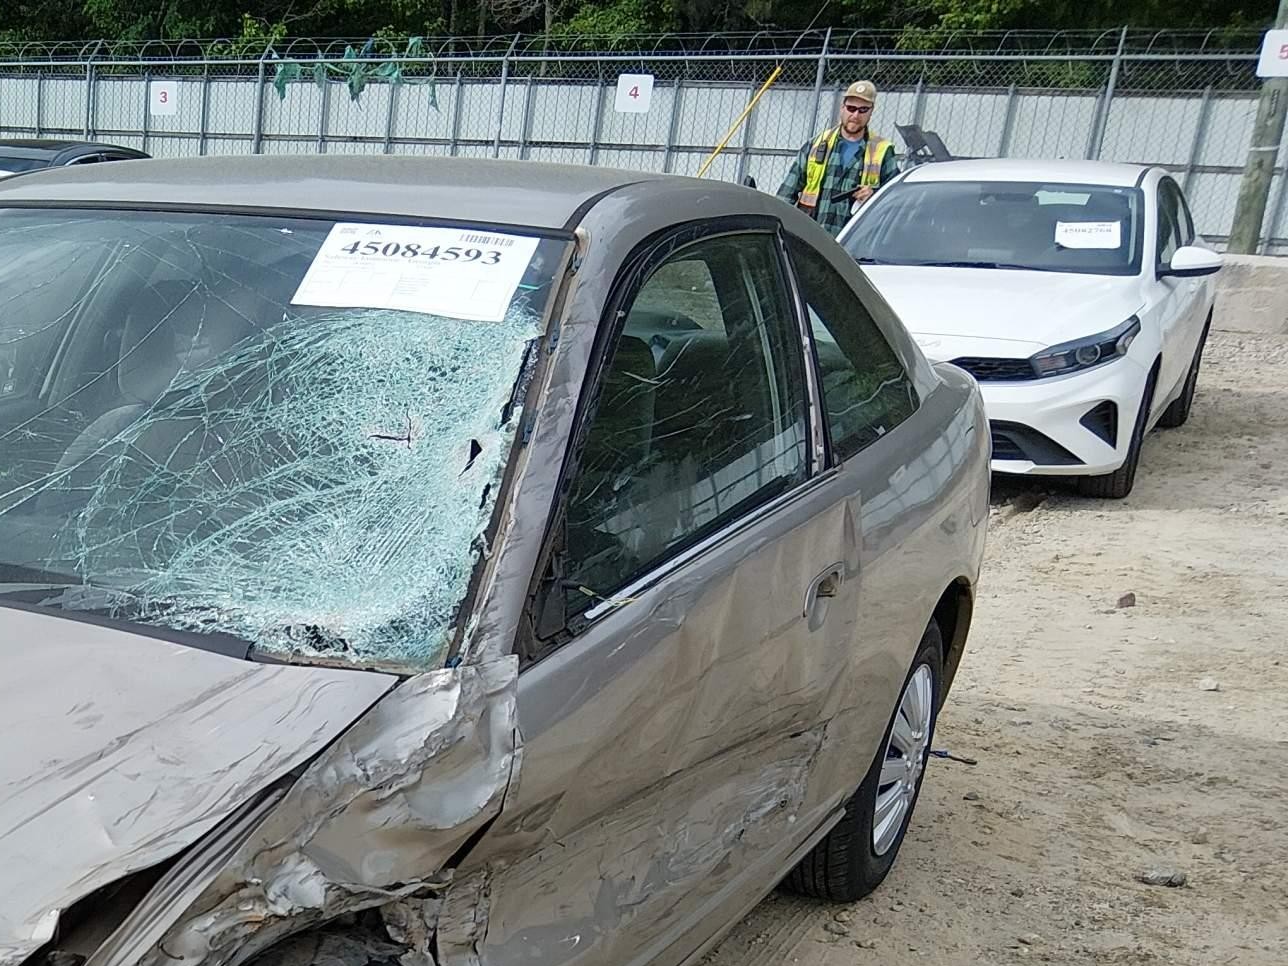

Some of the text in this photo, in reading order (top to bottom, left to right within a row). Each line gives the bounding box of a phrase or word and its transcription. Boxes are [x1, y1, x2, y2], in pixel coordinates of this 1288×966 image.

[159, 91, 168, 103] 3
[629, 86, 640, 99] 4
[340, 240, 503, 265] 45084593
